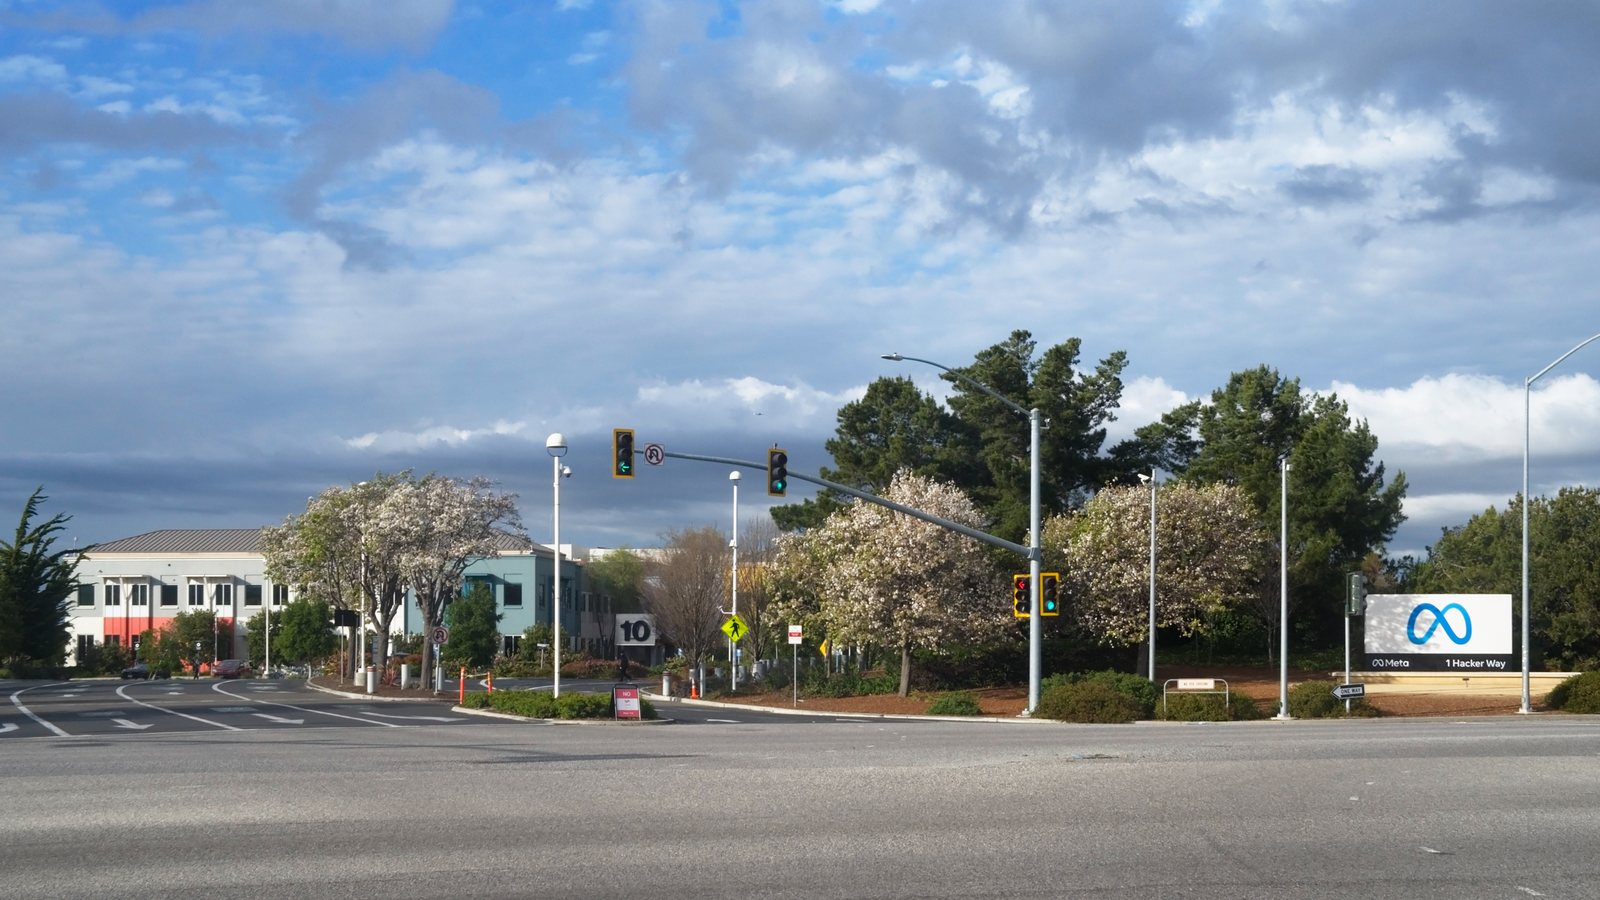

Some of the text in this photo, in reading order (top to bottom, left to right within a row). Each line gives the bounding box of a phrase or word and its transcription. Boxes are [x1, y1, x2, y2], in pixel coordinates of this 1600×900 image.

[620, 620, 651, 642] 10
[1385, 659, 1410, 668] Meta
[1445, 659, 1507, 670] 1 Hacker Way
